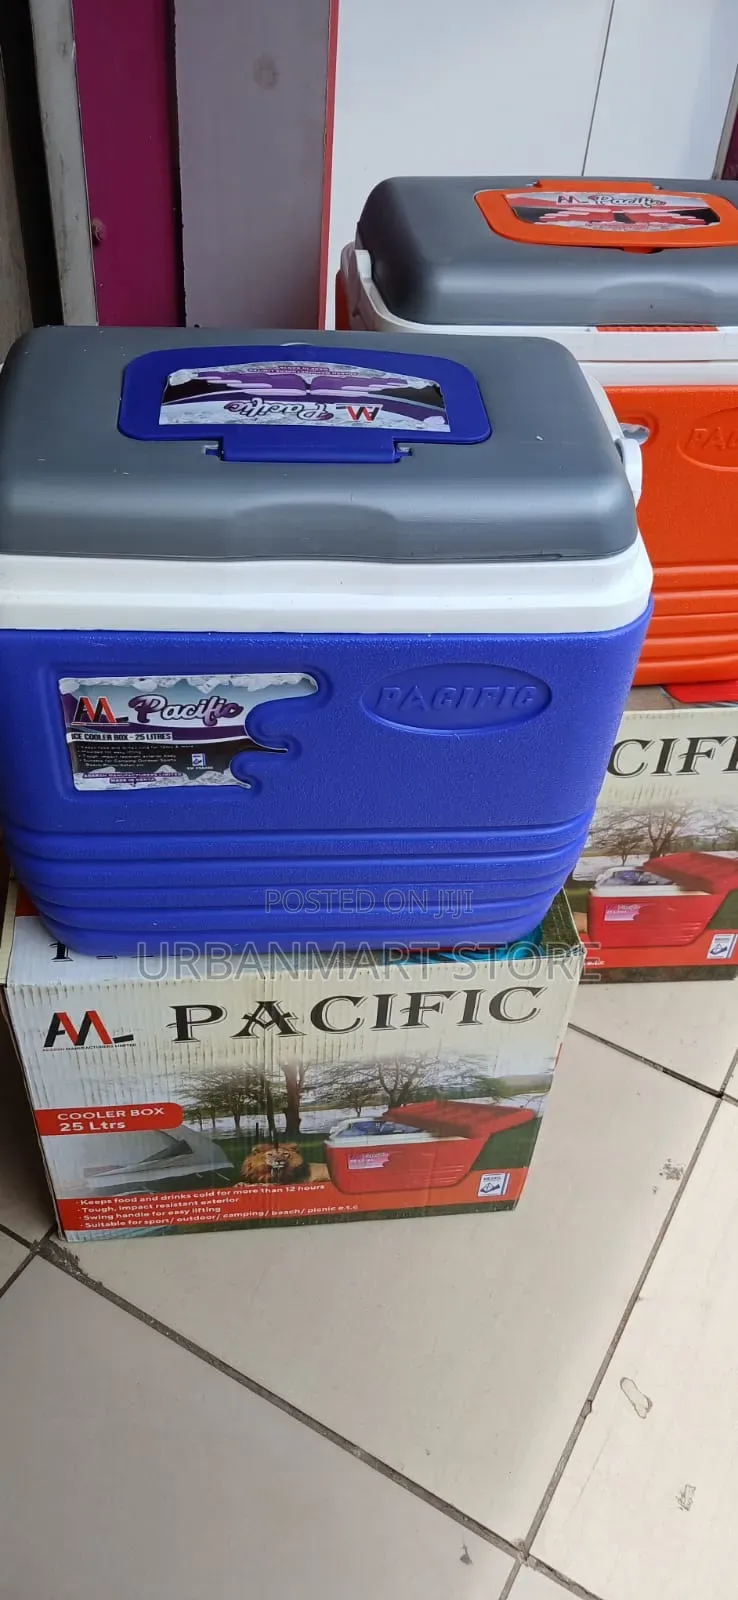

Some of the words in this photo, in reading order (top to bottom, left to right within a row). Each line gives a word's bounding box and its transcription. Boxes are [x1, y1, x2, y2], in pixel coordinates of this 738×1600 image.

[588, 195, 666, 208] Pacific
[224, 398, 334, 420] Pacific
[374, 685, 537, 712] PACIFIC
[128, 694, 244, 726] Pacific
[84, 733, 112, 741] COOLER
[165, 986, 548, 1044] PACIFIC
[57, 1108, 126, 1121] COOLER
[130, 1106, 165, 1117] BOX
[60, 1121, 83, 1132] 25
[89, 1120, 125, 1130] Ltrs
